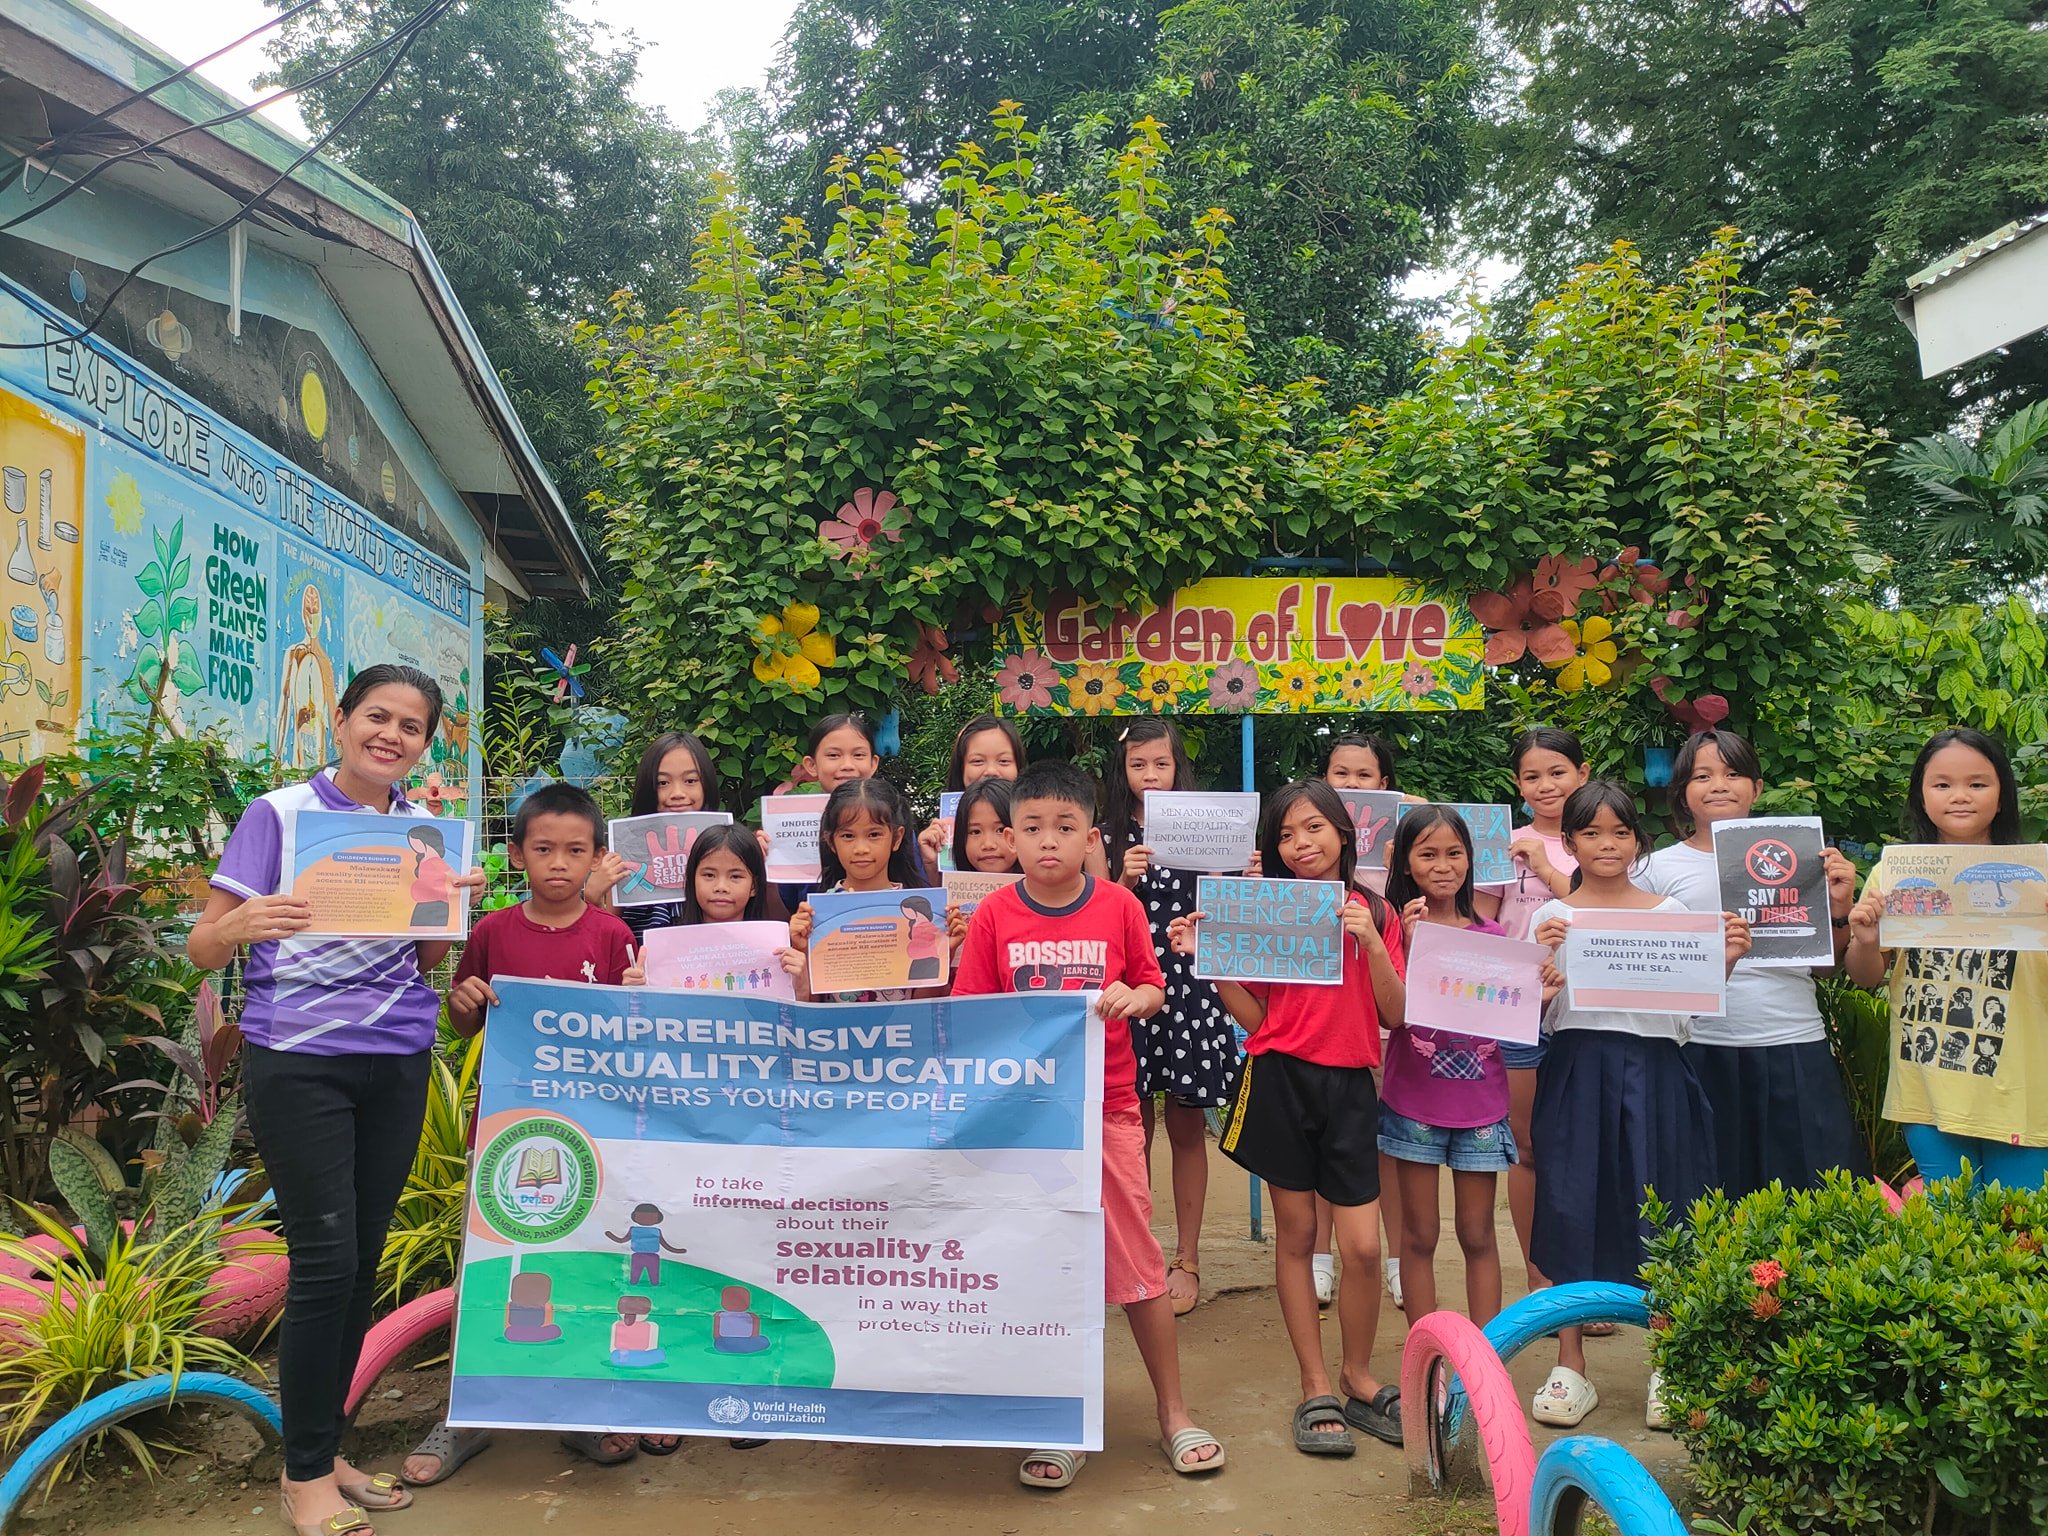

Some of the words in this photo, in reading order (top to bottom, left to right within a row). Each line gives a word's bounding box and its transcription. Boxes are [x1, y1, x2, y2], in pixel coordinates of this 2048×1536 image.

[44, 324, 210, 477] EXPLORE
[221, 443, 267, 505] INTO
[275, 466, 314, 536] THE
[323, 496, 387, 575] WORLD
[392, 550, 408, 579] OF
[412, 549, 463, 617] SCIENCE
[213, 523, 259, 567] HOW
[282, 541, 297, 560] THE
[299, 550, 331, 575] ANATOMY
[209, 598, 267, 642] PLANTS
[1043, 588, 1235, 662] Garden
[1245, 583, 1303, 662] of
[210, 628, 255, 664] MAKE
[208, 655, 253, 705] FOOD
[1161, 808, 1181, 817] MEN
[1183, 808, 1204, 817] AND
[1205, 809, 1243, 818] WOMEN
[782, 819, 820, 828] UNDERS
[1172, 821, 1182, 830] IN
[775, 830, 818, 838] SEXUALIT
[1154, 833, 1204, 843] ENDOWED
[1205, 834, 1229, 843] WITH
[1229, 834, 1248, 843] THE
[653, 853, 687, 869] STO
[1168, 847, 1194, 855] SAME
[1195, 847, 1233, 856] DIGNITY.
[1887, 855, 1953, 866] ADOLESCENT
[654, 866, 686, 878] SEXU
[655, 875, 684, 886] ASSA
[1890, 866, 1948, 876] PREGNANCY
[1201, 880, 1297, 902] BREAK
[1748, 888, 1776, 906] SAY
[1779, 887, 1799, 905] NO
[1200, 902, 1309, 926] SILENCE
[1738, 907, 1756, 924] TO
[1761, 906, 1809, 924] DRUGS
[1216, 932, 1338, 958] SEXUAL
[1590, 938, 1667, 948] UNDERSTAND
[1670, 940, 1701, 949] THAT
[1007, 939, 1109, 968] BOSSINI
[1582, 949, 1643, 960] SEXUALITY
[1646, 952, 1658, 960] IS
[1661, 953, 1676, 961] AS
[1679, 953, 1709, 962] WIDE
[1063, 966, 1088, 975] JEANS
[1089, 967, 1102, 976] CO.
[1216, 955, 1340, 979] VIOLENCE
[1608, 963, 1623, 971] AS
[1626, 963, 1648, 972] THE
[532, 1008, 912, 1051] COMPREHENSIVE
[533, 1044, 779, 1080] SEXUALITY
[791, 1057, 1056, 1085] EDUCATION
[531, 1079, 711, 1106] EMPOWERS
[721, 1087, 834, 1109] YOUNG
[846, 1090, 967, 1111] PEOPLE
[480, 1127, 527, 1199] AMANCOSILING
[528, 1122, 586, 1154] ELEMENTARY
[696, 1176, 715, 1189] to
[722, 1177, 764, 1191] take
[693, 1194, 785, 1210] informed
[791, 1198, 889, 1212] decisions
[533, 1204, 586, 1239] PANGASINAN
[776, 1217, 835, 1230] about
[842, 1218, 889, 1230] their
[776, 1237, 932, 1263] sexuality
[941, 1239, 965, 1261] &
[776, 1264, 1000, 1294] relationships
[858, 1296, 875, 1310] in
[882, 1300, 894, 1310] a
[900, 1300, 941, 1315] way
[947, 1300, 988, 1314] that
[858, 1318, 941, 1334] protects
[947, 1321, 996, 1335] their
[1001, 1322, 1072, 1337] health.
[753, 1402, 785, 1412] World
[788, 1402, 826, 1413] Health
[752, 1412, 826, 1424] Organization
